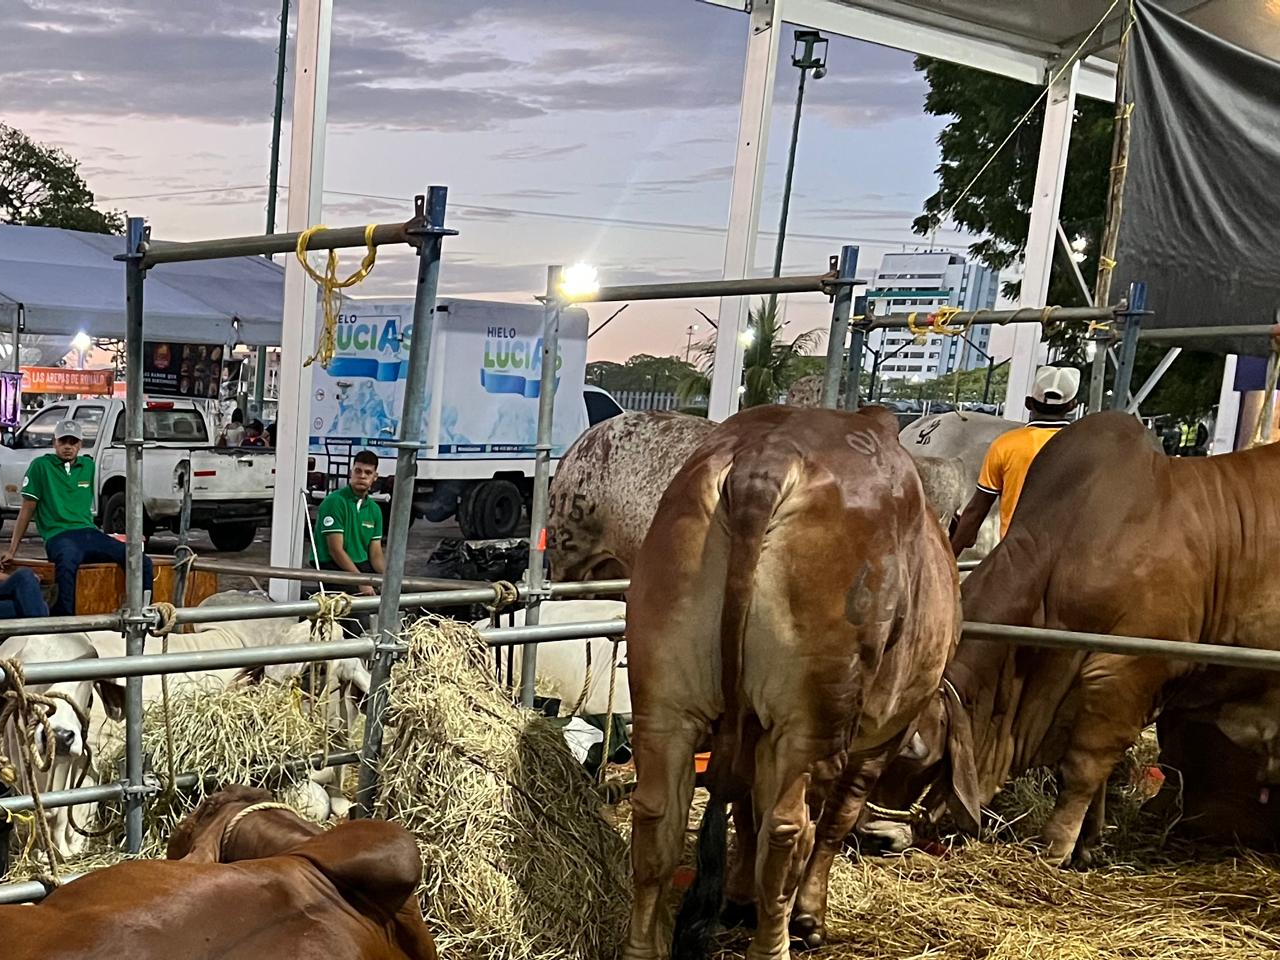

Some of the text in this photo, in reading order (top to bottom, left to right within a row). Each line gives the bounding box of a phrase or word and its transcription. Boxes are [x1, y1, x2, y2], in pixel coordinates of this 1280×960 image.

[336, 319, 412, 353] UCIAS
[487, 326, 516, 339] HIELO
[32, 371, 45, 383] LAS
[46, 372, 70, 385] AREPAS
[70, 373, 79, 385] DE
